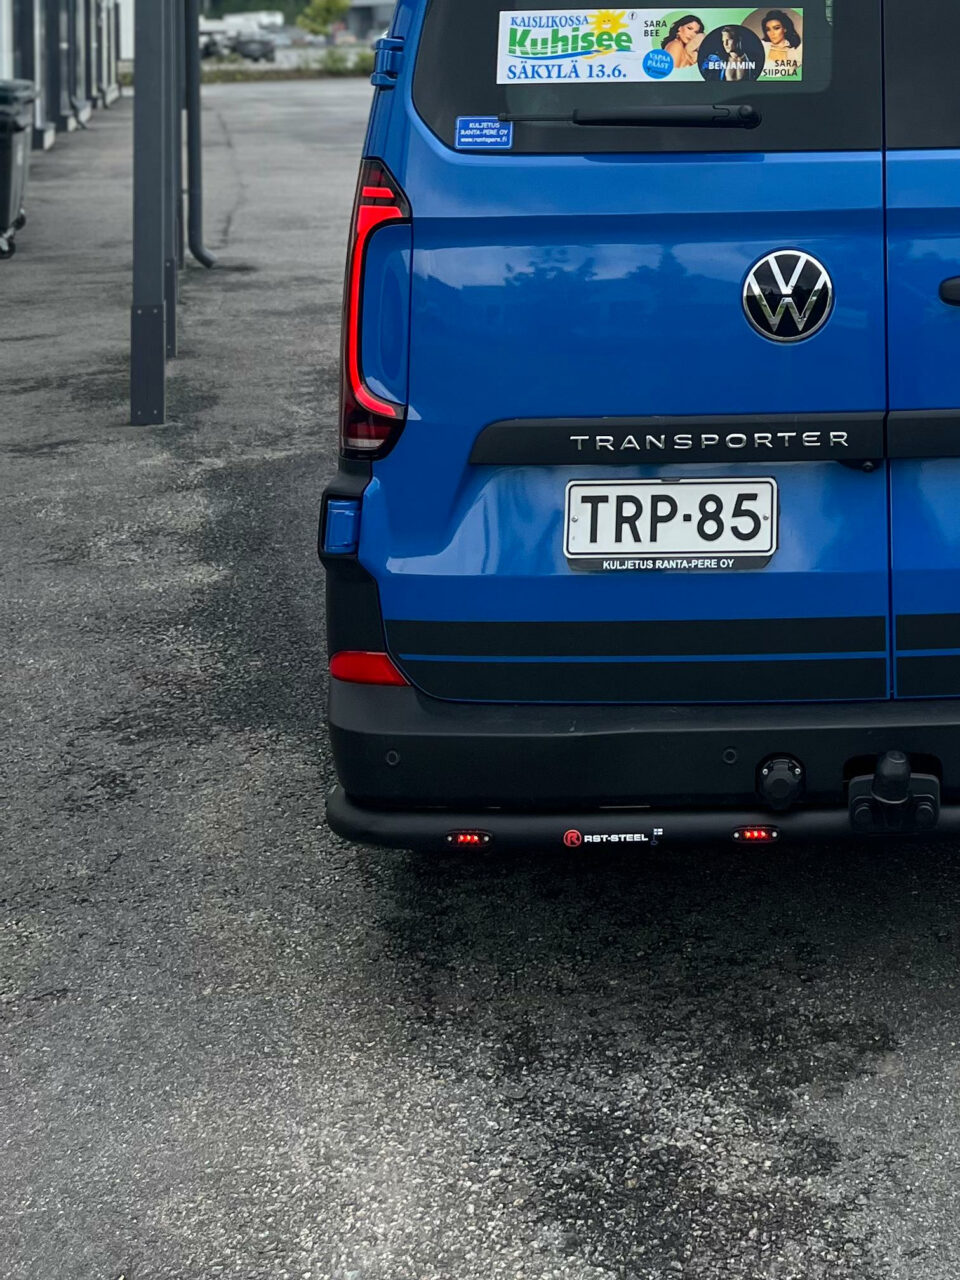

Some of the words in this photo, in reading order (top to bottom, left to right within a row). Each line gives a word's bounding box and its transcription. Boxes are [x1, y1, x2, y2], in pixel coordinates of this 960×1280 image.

[510, 15, 589, 28] KAISLIKOSSA
[643, 20, 667, 28] SARA
[643, 29, 660, 37] BEE
[508, 27, 633, 56] Kuhisee
[708, 61, 756, 70] BENJAMIN
[774, 59, 798, 67] SARA
[507, 60, 580, 80] SÄKYLÄ
[587, 63, 627, 79] 13.6.
[763, 68, 798, 77] SIIPOLA
[570, 431, 849, 451] TRANSPORTER
[580, 493, 762, 544] TRP-85
[602, 559, 653, 570] KULJETUS
[655, 559, 718, 569] RANTA-PERE
[720, 558, 735, 568] OY
[584, 833, 649, 843] RST-STEEL
